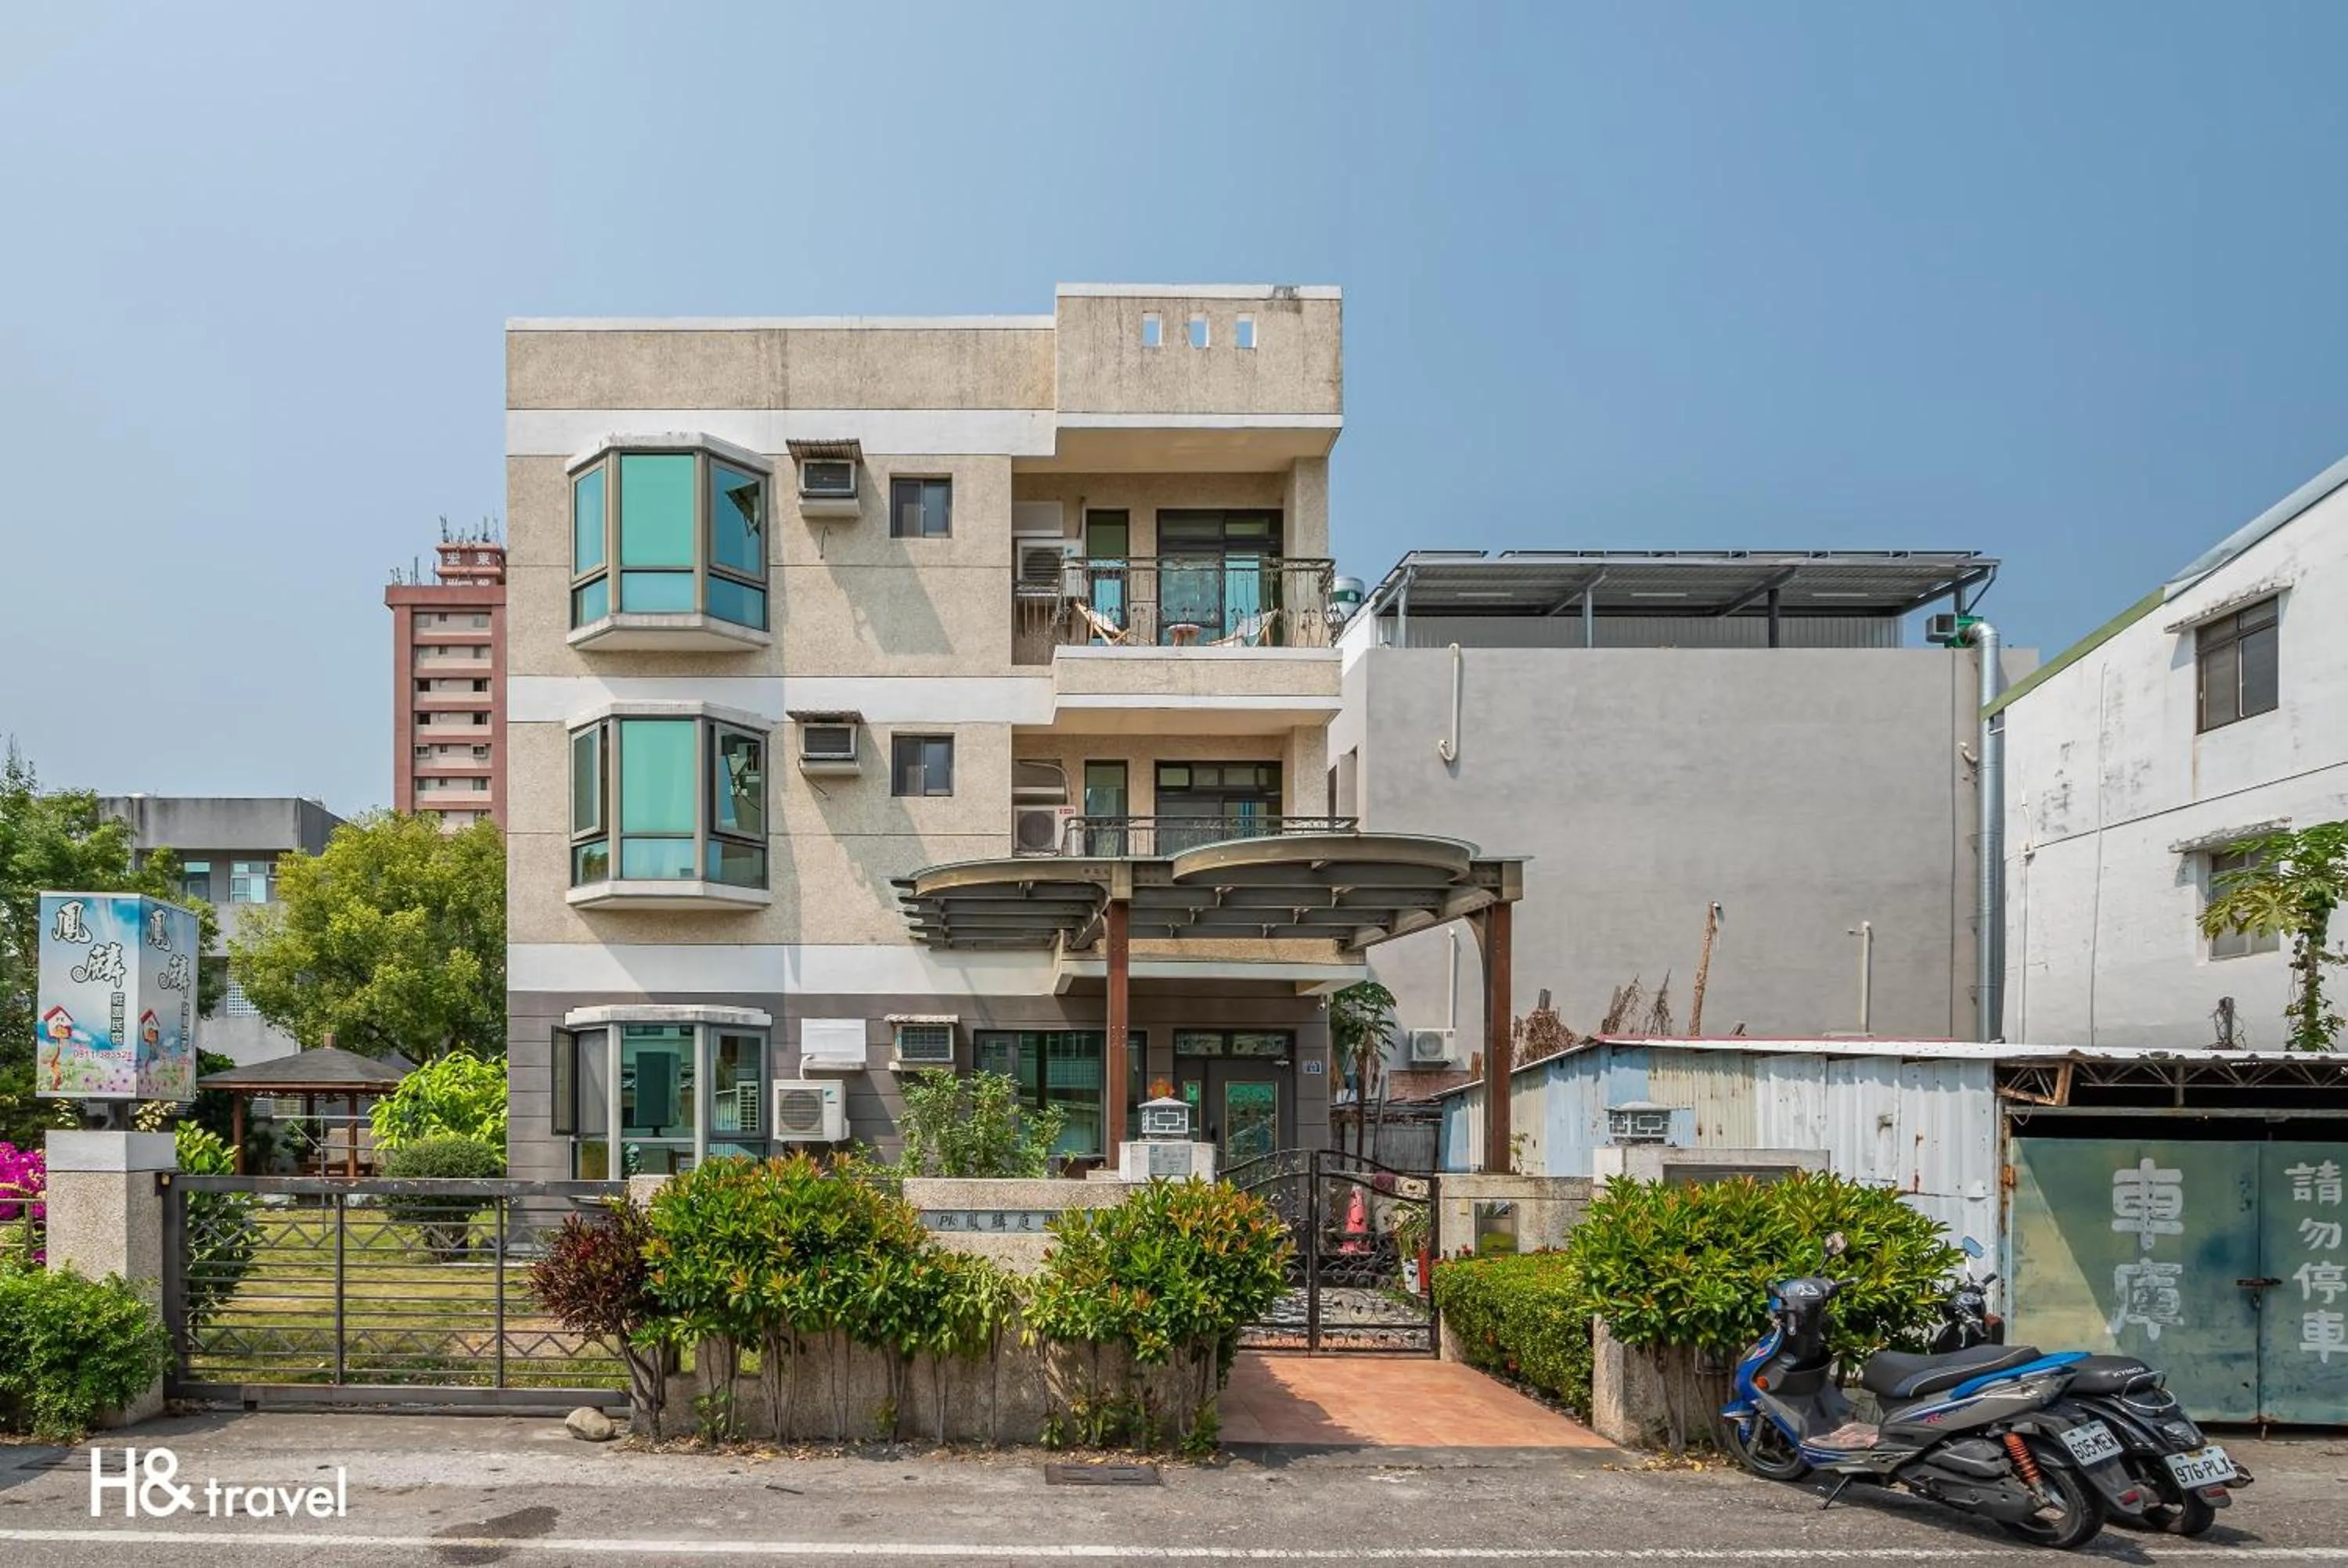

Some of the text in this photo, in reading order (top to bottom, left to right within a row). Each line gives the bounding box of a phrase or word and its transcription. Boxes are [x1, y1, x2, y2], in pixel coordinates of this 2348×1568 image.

[2105, 1157, 2184, 1341] 車庫
[2283, 1159, 2348, 1364] 請勿停車
